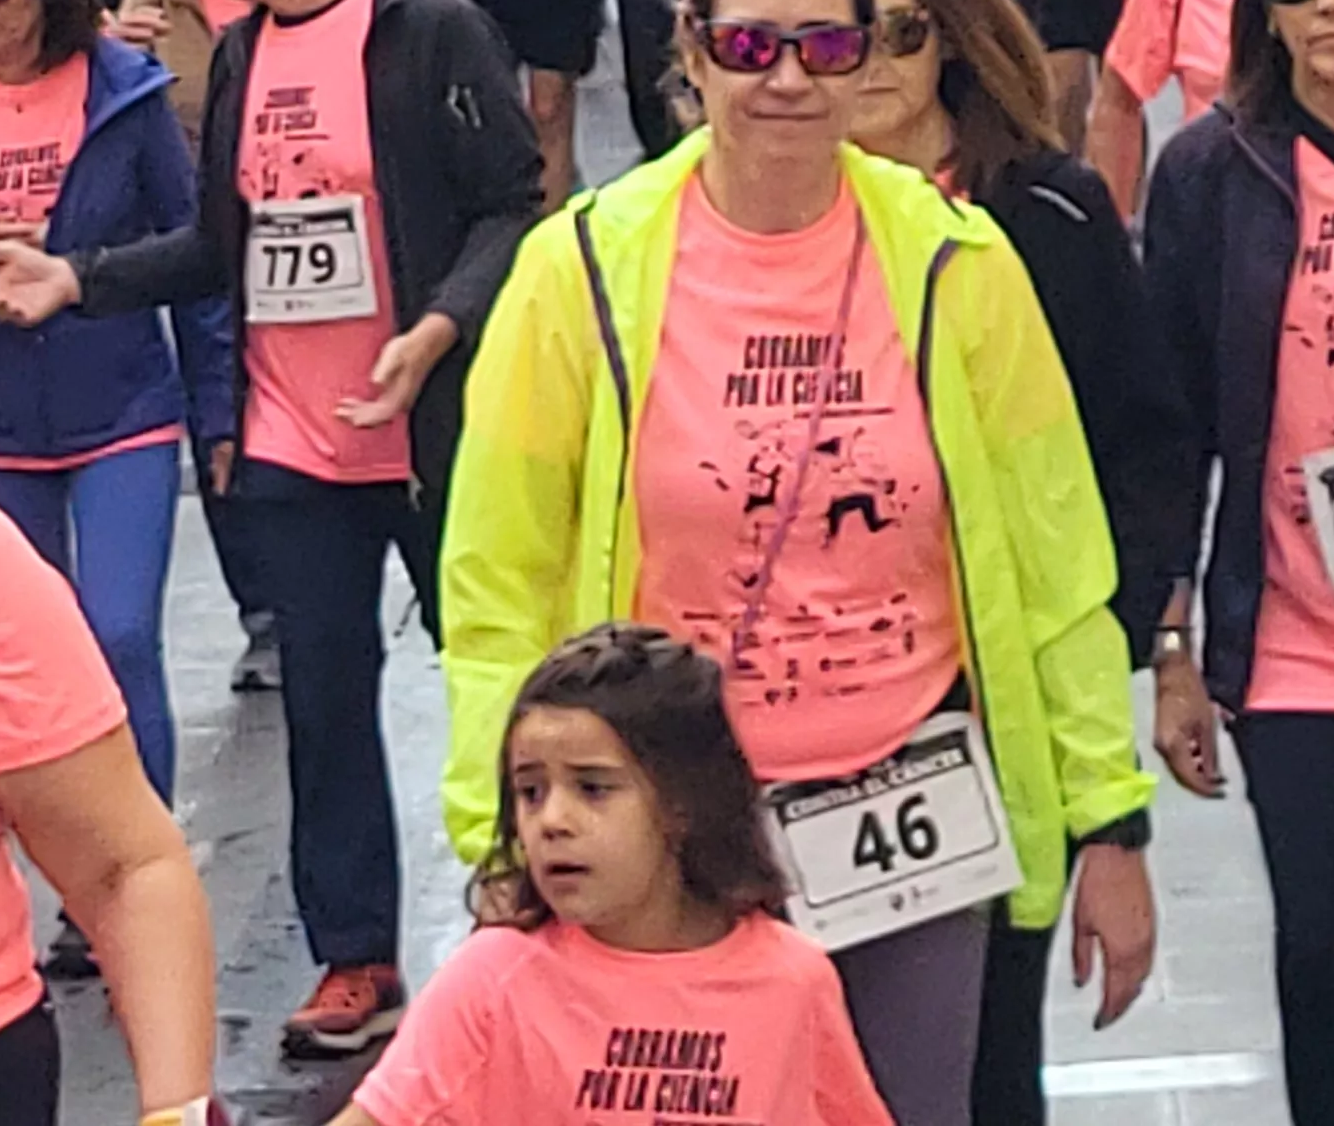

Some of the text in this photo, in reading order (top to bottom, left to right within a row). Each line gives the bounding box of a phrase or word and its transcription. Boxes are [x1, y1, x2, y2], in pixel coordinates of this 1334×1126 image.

[723, 373, 760, 407] POR
[766, 373, 786, 407] LA
[853, 791, 940, 872] 46
[605, 1027, 726, 1072] CORRAMOS
[574, 1070, 621, 1112] POR
[623, 1072, 650, 1112] LA
